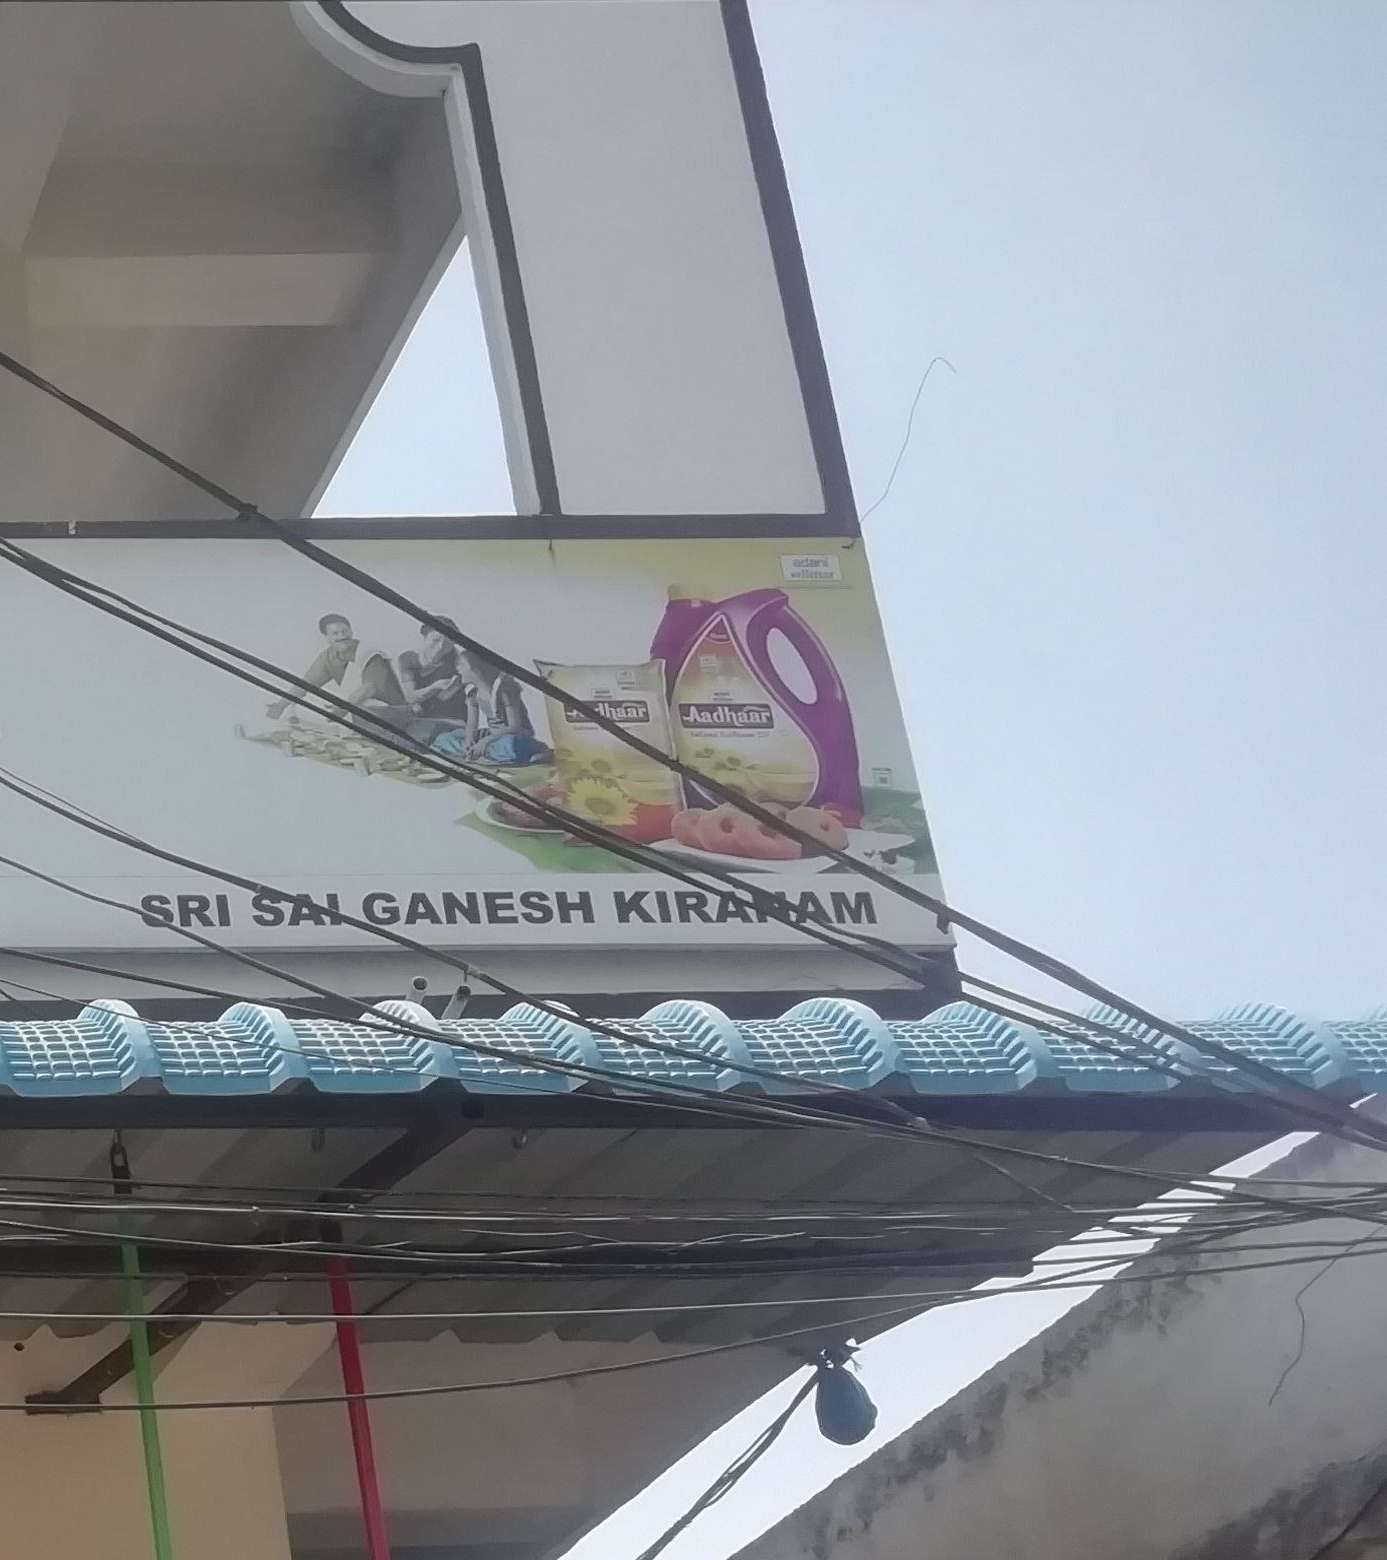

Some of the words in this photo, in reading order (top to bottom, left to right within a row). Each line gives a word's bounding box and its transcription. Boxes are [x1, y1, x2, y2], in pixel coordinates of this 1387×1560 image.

[683, 705, 771, 728] Aadhaar
[139, 893, 231, 928] SRI
[251, 893, 342, 928] SAI
[361, 891, 597, 926] GANESH
[613, 891, 879, 926] KIRANAM
